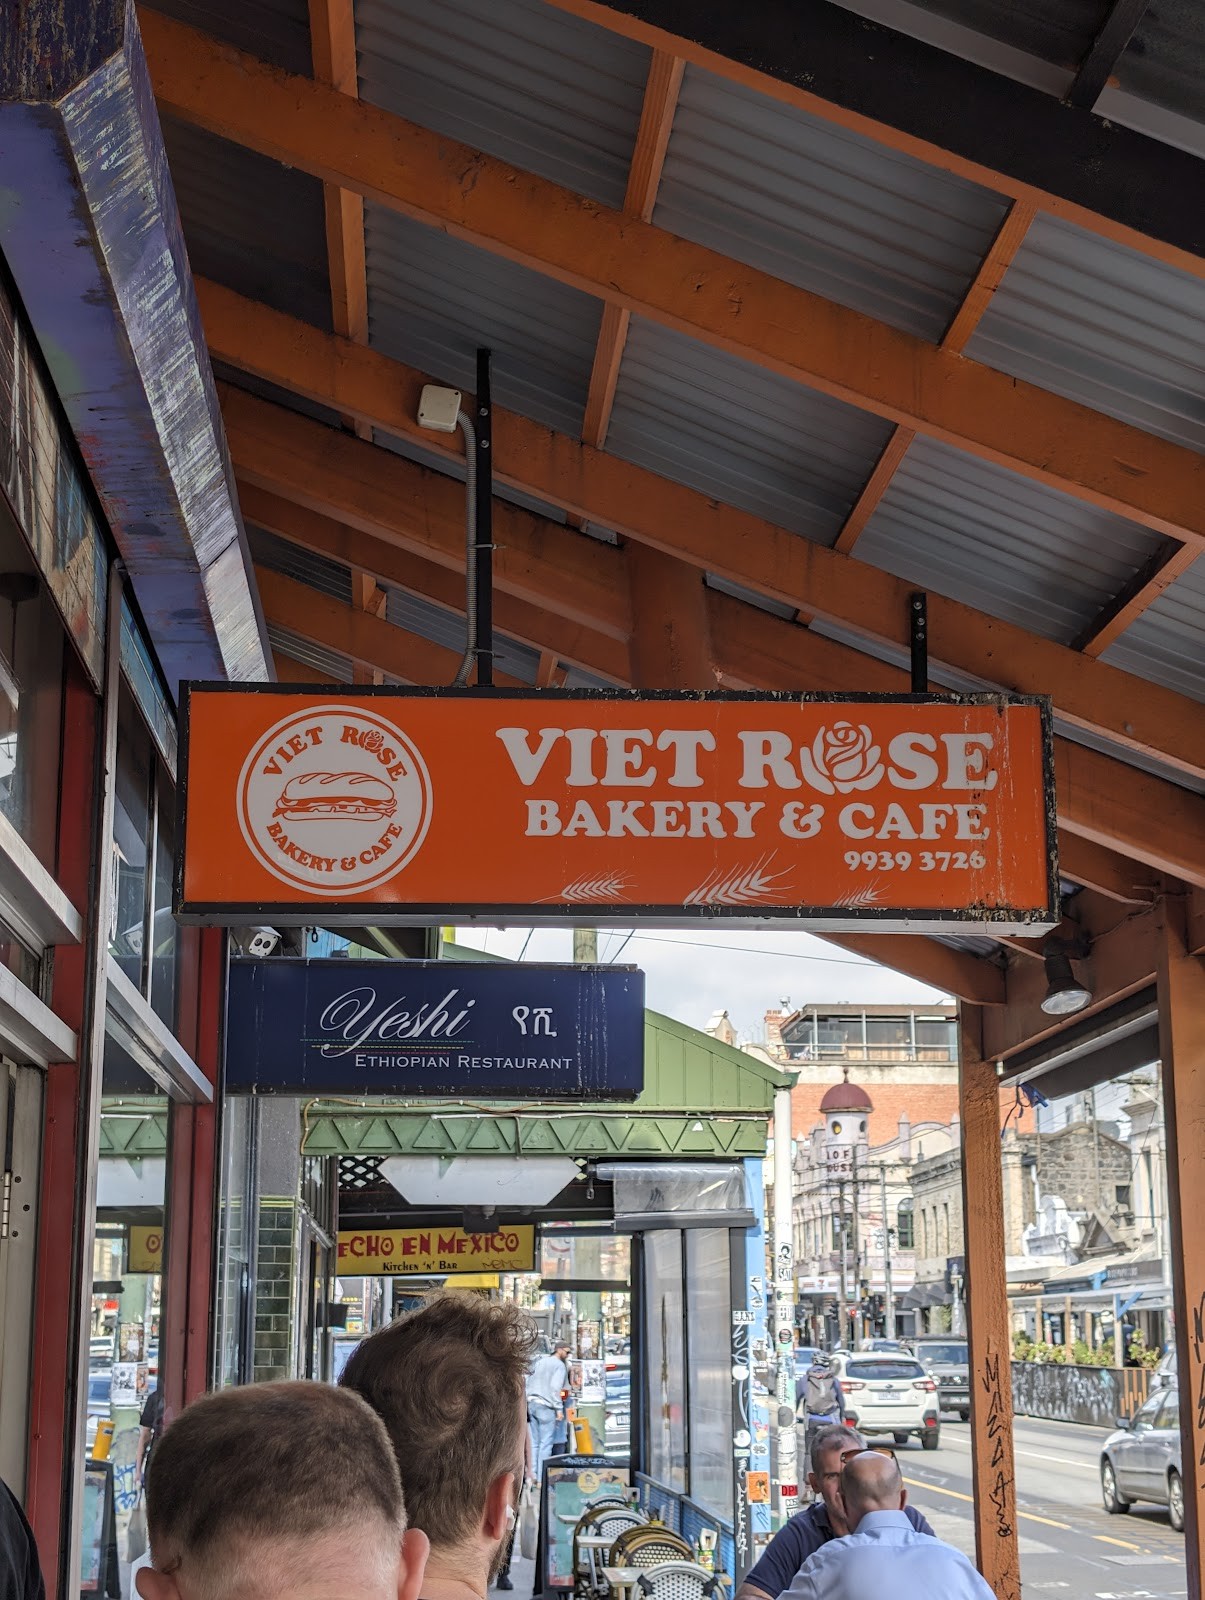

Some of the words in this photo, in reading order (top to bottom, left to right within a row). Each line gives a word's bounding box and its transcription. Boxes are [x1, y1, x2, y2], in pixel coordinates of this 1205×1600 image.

[263, 726, 324, 777] VIET
[495, 727, 716, 788] VIET
[524, 799, 766, 839] BAKERY
[779, 803, 822, 839] &
[838, 802, 991, 841] CAFE
[265, 821, 338, 873] BAKERY
[340, 856, 357, 872] &
[359, 822, 404, 867] CAFE
[844, 850, 911, 872] 9939
[919, 850, 986, 871] 3726
[319, 986, 476, 1059] Yeshi
[402, 1232, 431, 1256] EN
[437, 1231, 520, 1255] MEXICO
